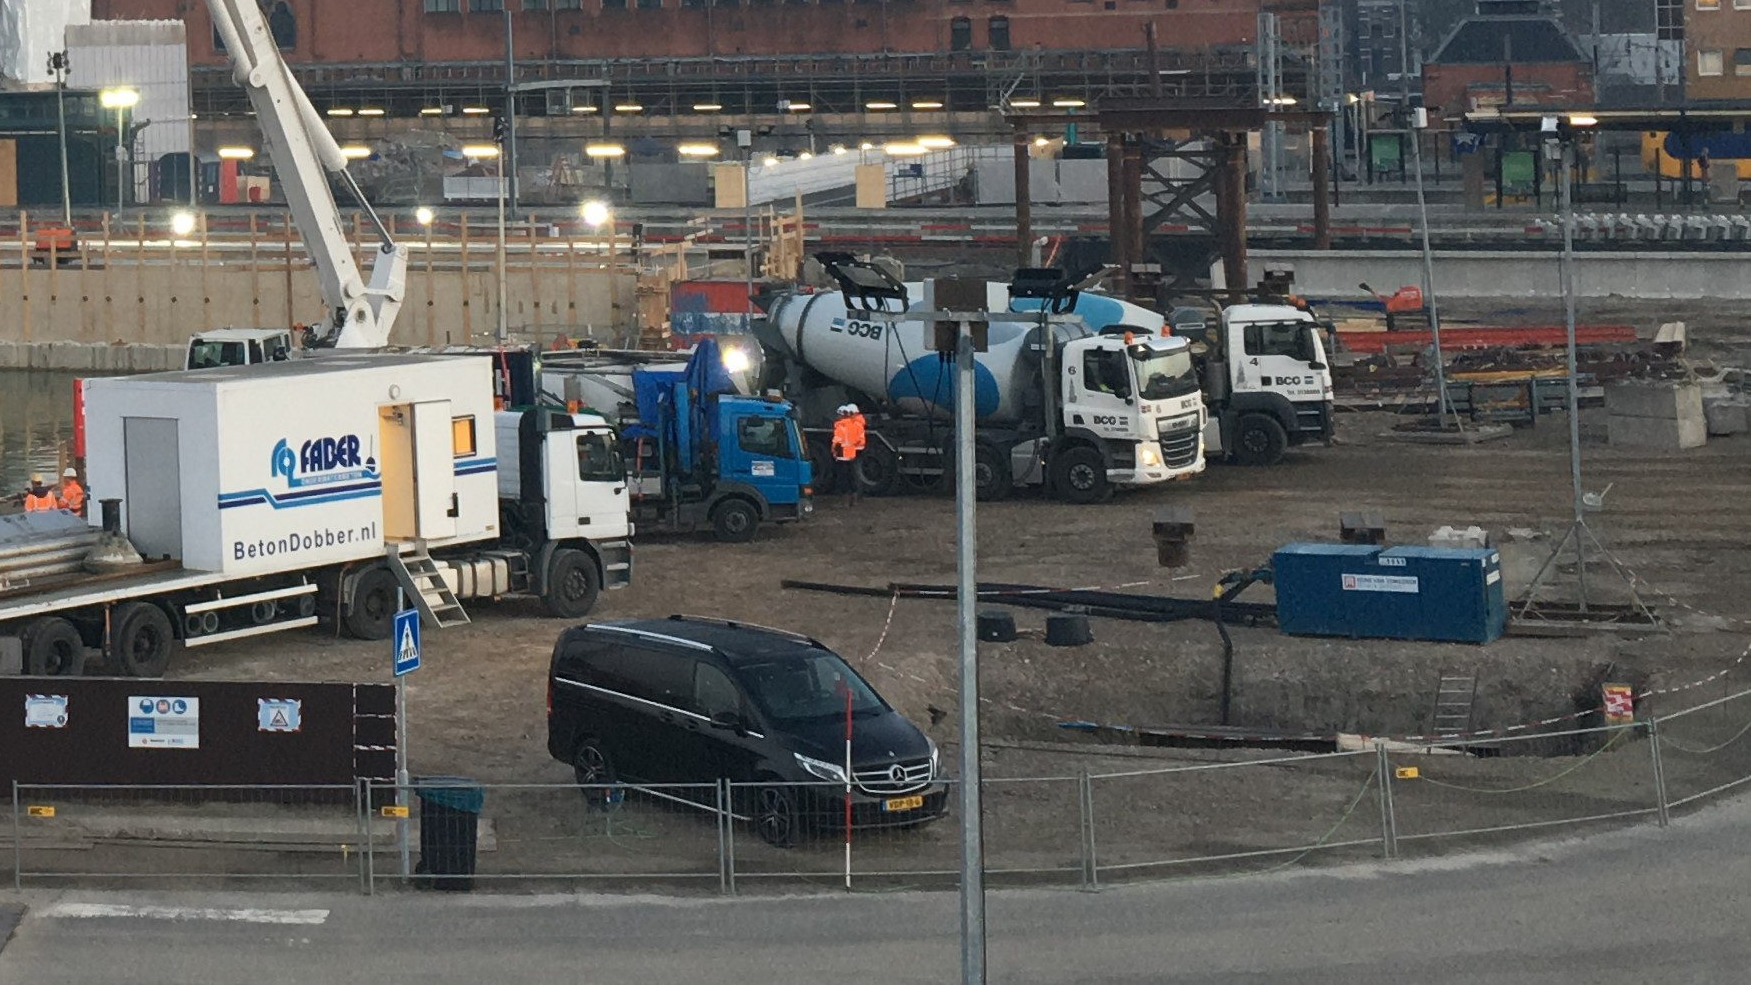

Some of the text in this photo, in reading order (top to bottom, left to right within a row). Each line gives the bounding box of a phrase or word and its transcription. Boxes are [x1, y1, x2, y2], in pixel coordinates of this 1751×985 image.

[848, 320, 883, 341] BCG
[1249, 357, 1259, 367] 4
[1068, 366, 1077, 375] 6
[1275, 376, 1301, 386] BCG
[1093, 415, 1117, 425] BCG
[300, 434, 361, 473] FADER
[234, 521, 376, 560] BetonDobber.nl
